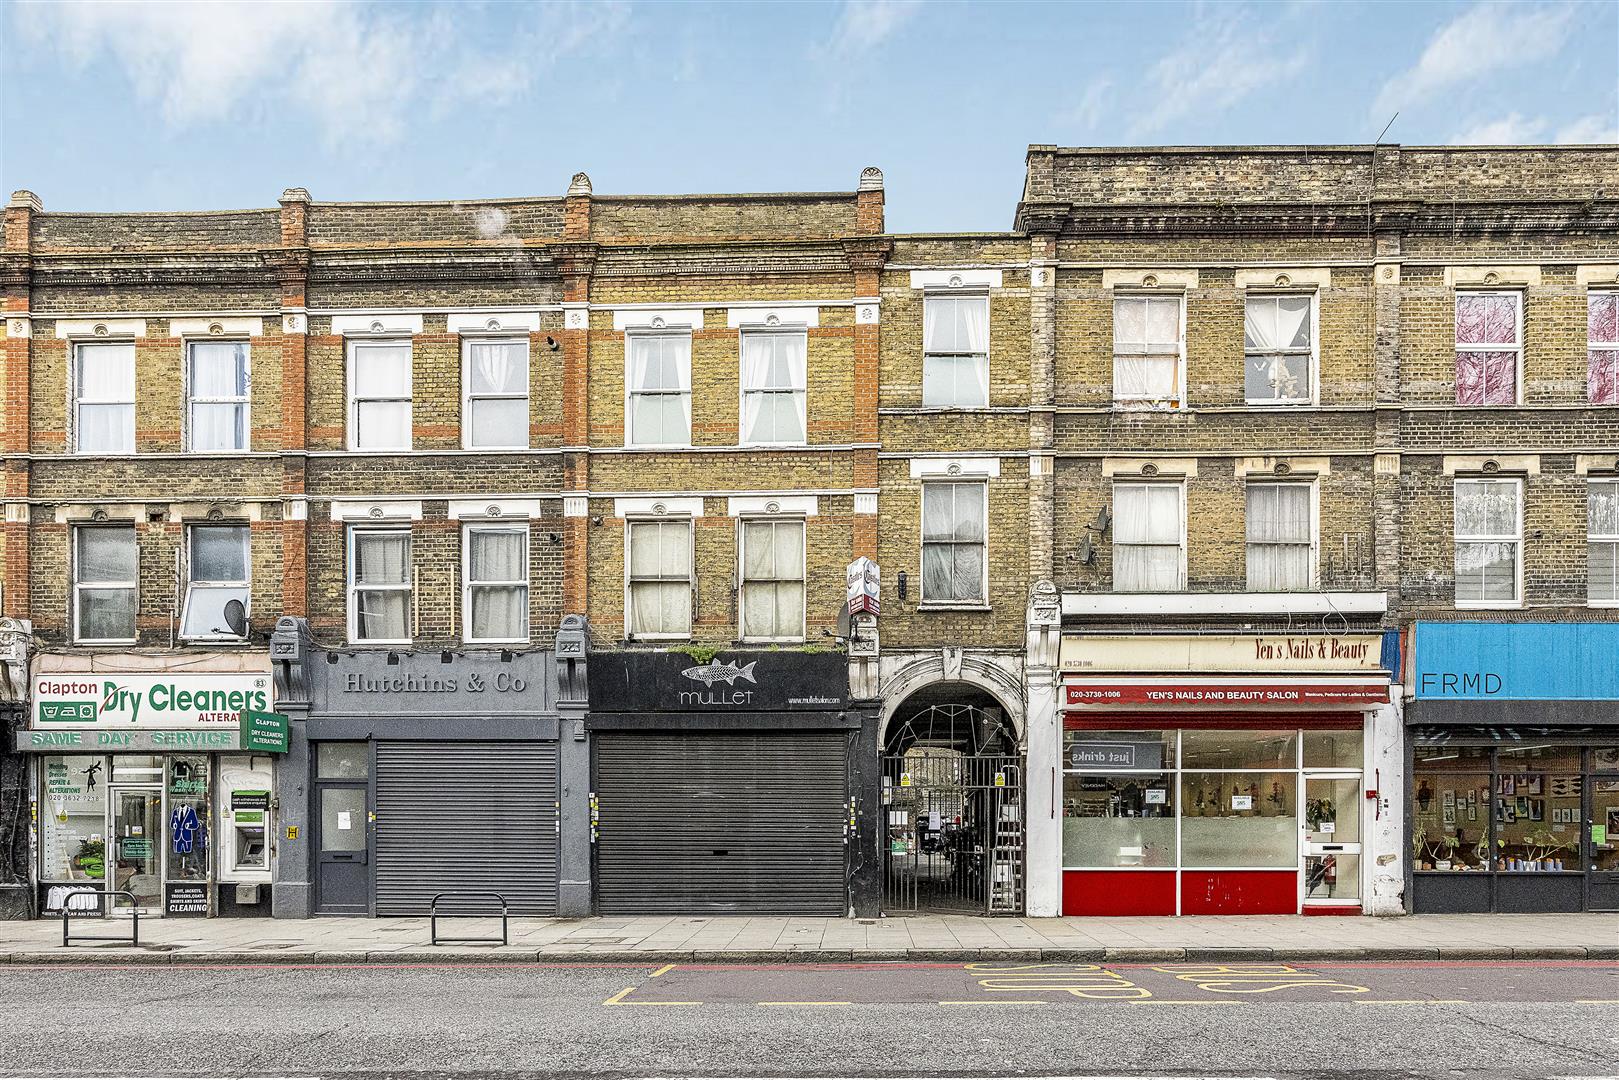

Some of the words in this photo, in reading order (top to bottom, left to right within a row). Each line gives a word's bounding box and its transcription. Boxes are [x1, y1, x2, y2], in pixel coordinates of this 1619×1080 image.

[1286, 638, 1314, 659] Nails
[1318, 638, 1326, 659] &
[1330, 638, 1369, 664] Beauty
[39, 681, 97, 696] Clapton
[343, 673, 457, 693] Hutchins
[464, 672, 485, 693] &
[493, 672, 527, 693] Co
[1421, 673, 1502, 694] FRMD
[1146, 691, 1174, 699] YEN'S
[1175, 691, 1203, 699] NAILS
[1204, 691, 1225, 699] AND
[1226, 691, 1265, 699] BEAUTY
[1266, 691, 1299, 699] SALON
[103, 681, 142, 722] Dry
[148, 684, 267, 711] Cleaners
[198, 713, 240, 722] ALTERAT
[255, 718, 280, 727] CLAPTON
[31, 732, 82, 745] SAME
[97, 732, 135, 745] DAY
[153, 732, 233, 745] SERVICE
[261, 730, 284, 739] CLEANERS
[253, 737, 283, 746] ALTERATIONS
[287, 826, 298, 838] H
[169, 904, 208, 912] CLEANING
[963, 963, 1153, 999] STOP
